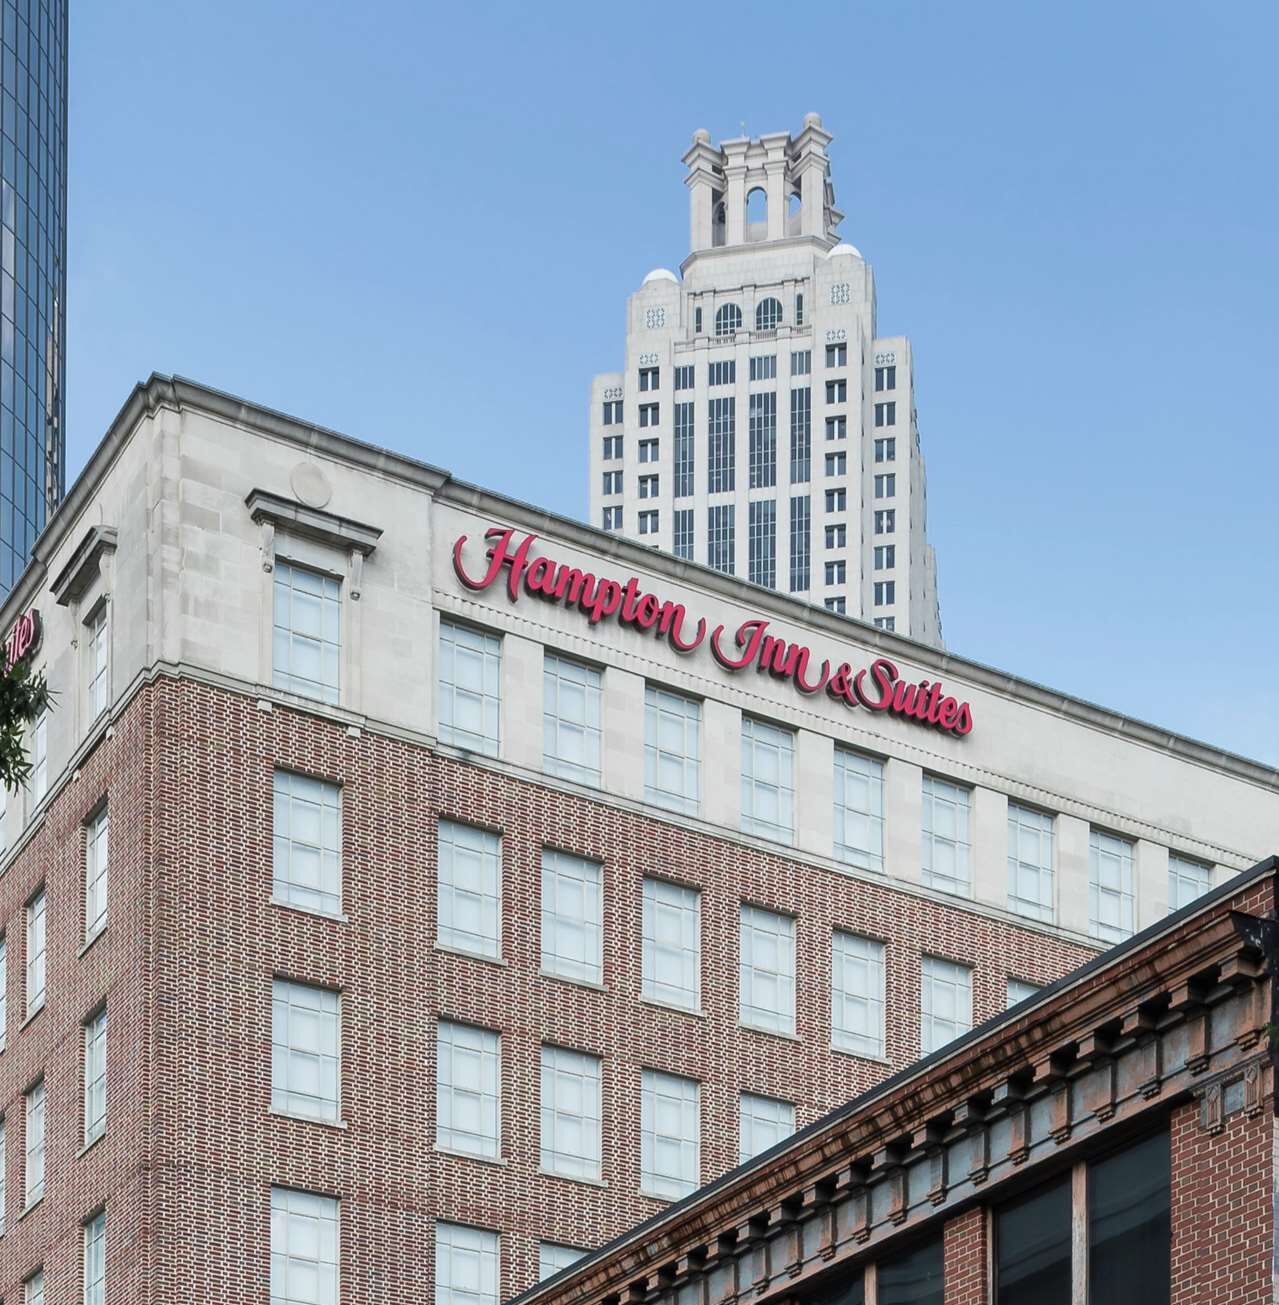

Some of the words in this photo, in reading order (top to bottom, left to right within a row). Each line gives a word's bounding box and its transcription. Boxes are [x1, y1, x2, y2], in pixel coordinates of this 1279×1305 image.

[452, 527, 707, 653] Hampton
[710, 618, 832, 693] Inn
[825, 660, 857, 708] &
[853, 656, 976, 738] Suites
